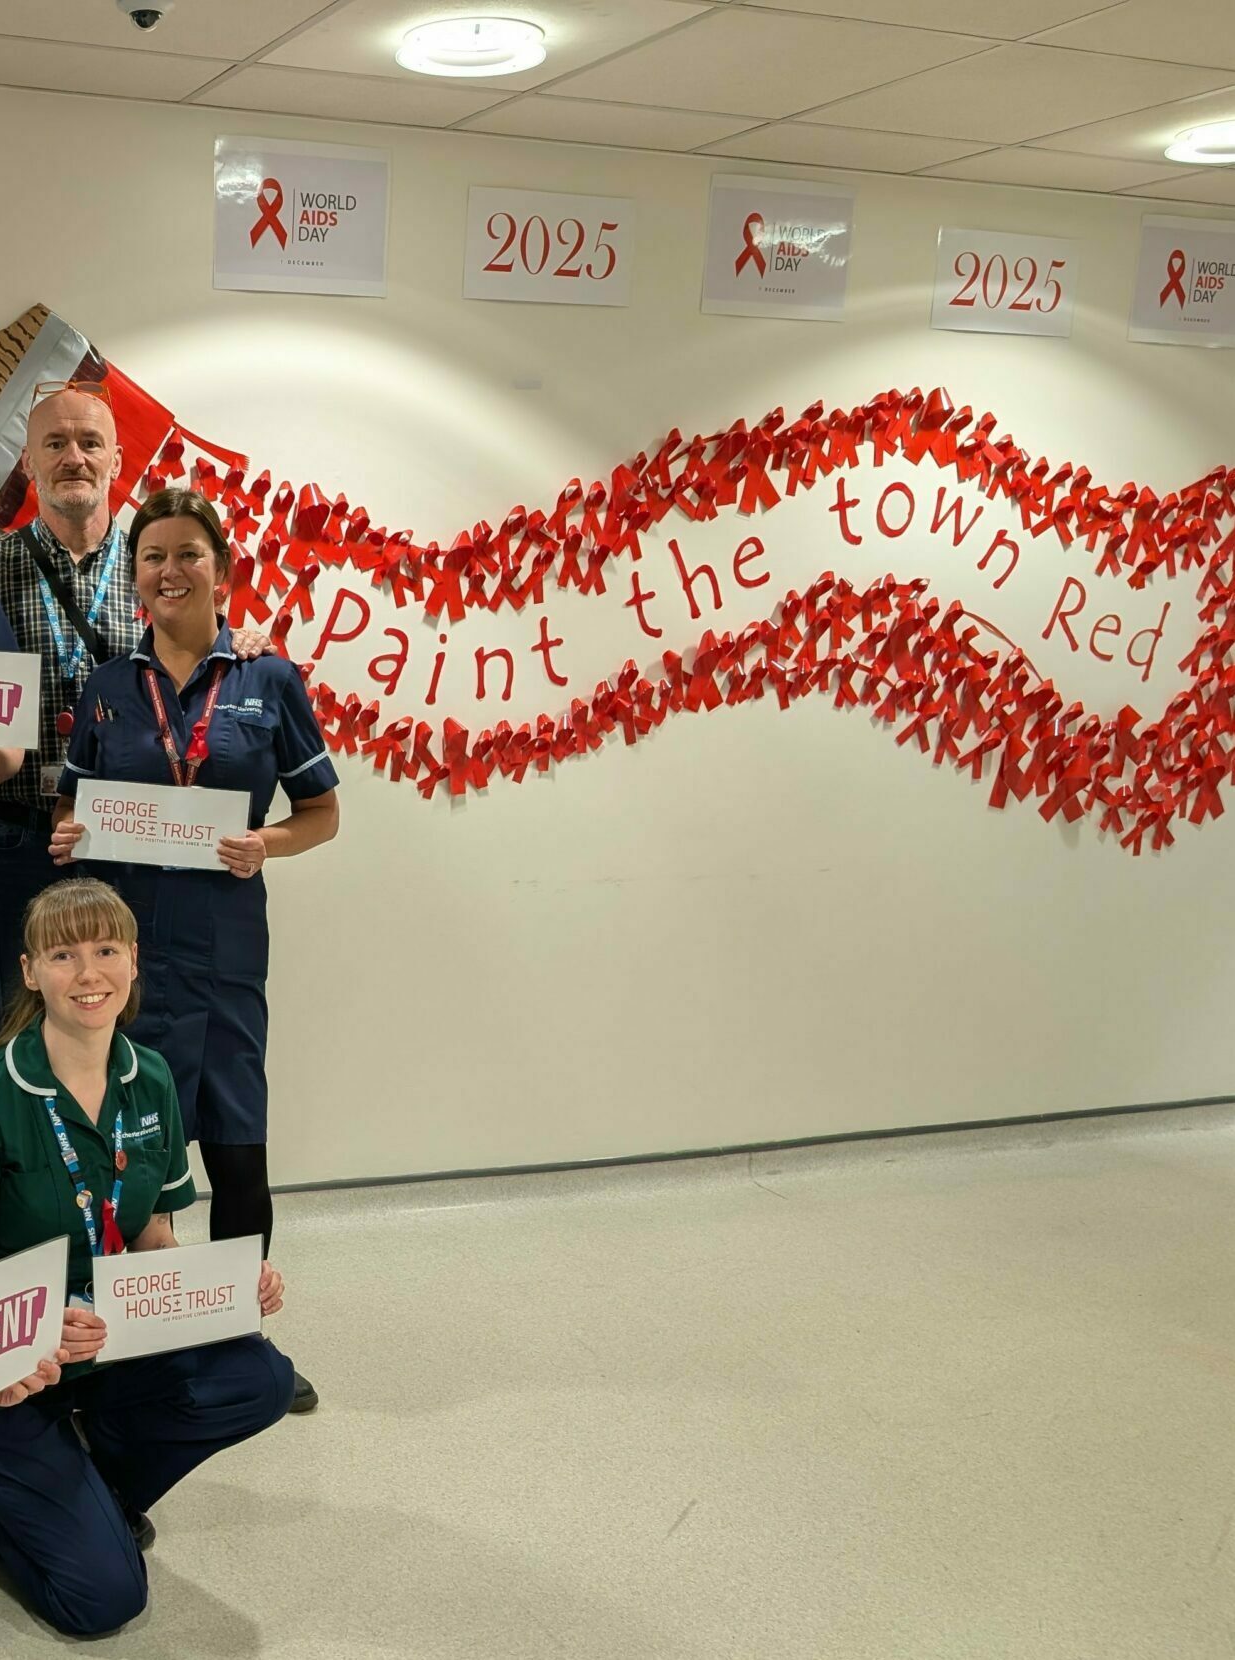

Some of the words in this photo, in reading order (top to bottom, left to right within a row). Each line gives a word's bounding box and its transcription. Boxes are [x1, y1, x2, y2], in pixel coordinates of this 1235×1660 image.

[300, 192, 357, 211] WORLD
[299, 209, 338, 226] AIDS
[298, 226, 329, 243] DAY
[482, 211, 619, 280] 2025
[776, 240, 810, 257] AIDS
[287, 259, 324, 267] DECEMBER
[774, 256, 802, 272] DAY
[764, 286, 796, 294] DECEMBER
[948, 250, 1066, 313] 2025
[1195, 275, 1225, 290] AIDS
[1192, 289, 1217, 303] DAY
[312, 588, 569, 706] Paint
[625, 535, 770, 639] the
[828, 476, 1021, 590] town
[1041, 576, 1173, 682] Red
[57, 641, 66, 657] NHS
[244, 697, 263, 707] NHS
[91, 798, 159, 819] GEORGE
[160, 822, 216, 841] TRUST
[140, 1112, 159, 1127] NHS
[49, 1107, 63, 1126] NHS
[58, 1132, 71, 1150] NHS
[83, 1208, 93, 1222] NH
[87, 1226, 97, 1245] NHS
[113, 1271, 182, 1298] GEORGE
[185, 1285, 236, 1310] TRUST
[171, 1312, 193, 1321] POSITIVE
[193, 1309, 210, 1318] LIVING
[210, 1307, 224, 1315] SINCE
